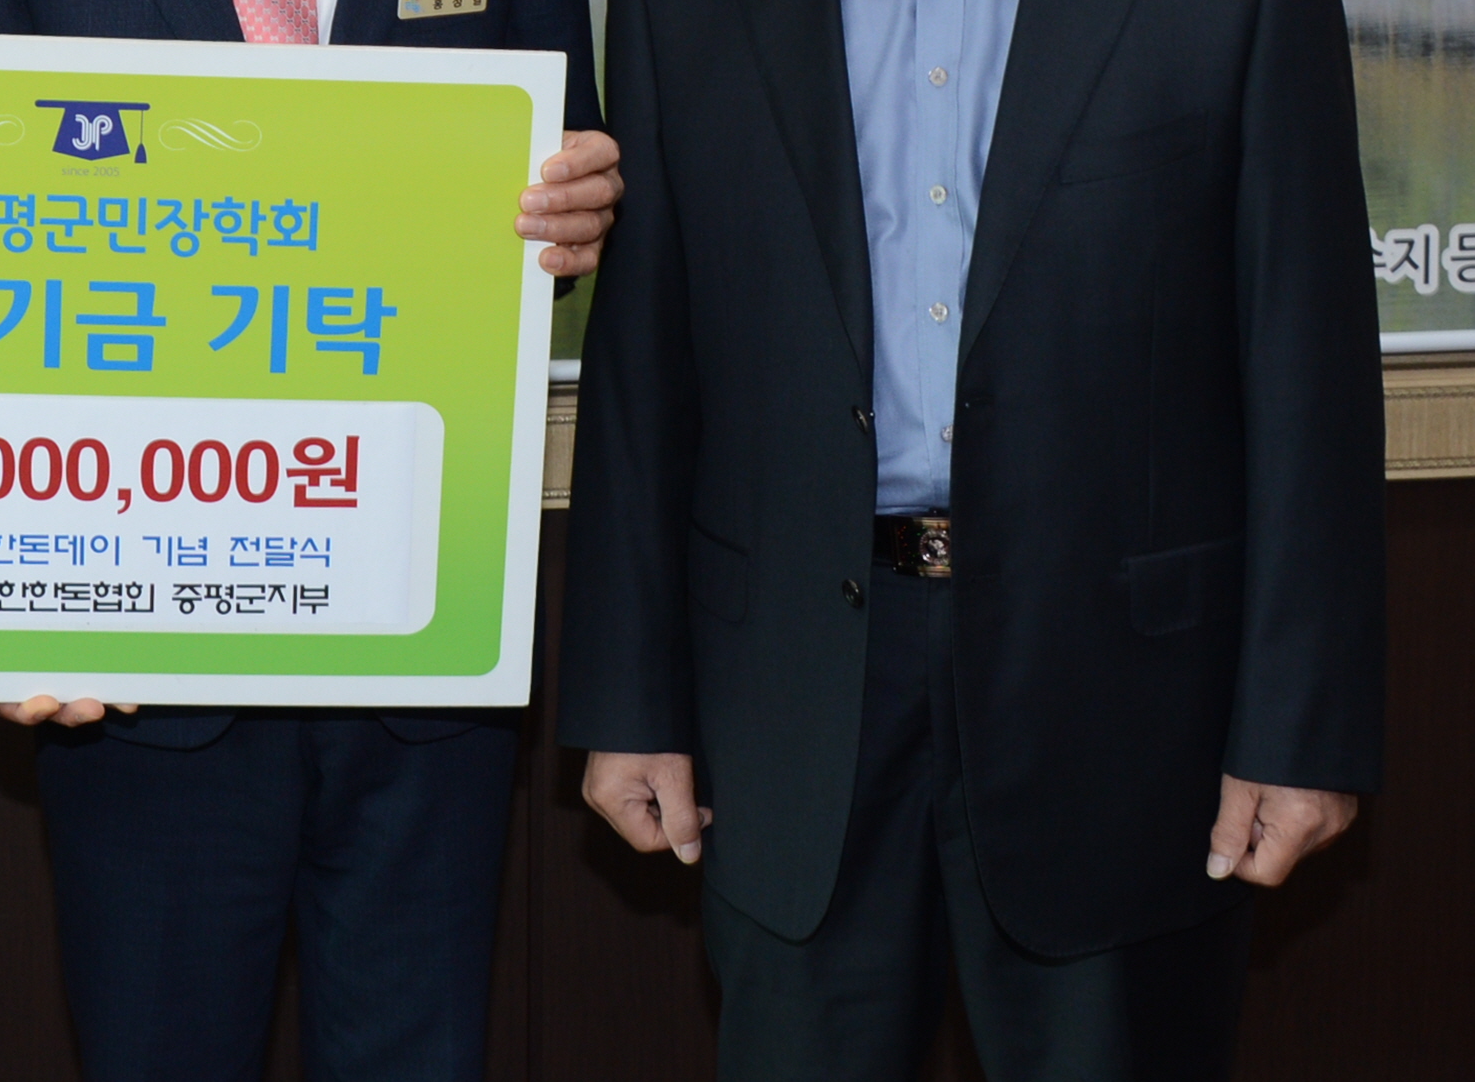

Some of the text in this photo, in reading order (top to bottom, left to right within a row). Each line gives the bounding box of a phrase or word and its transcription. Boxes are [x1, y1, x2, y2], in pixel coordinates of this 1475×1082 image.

[62, 166, 120, 177] since 2005
[208, 284, 398, 376] 기탁
[141, 534, 210, 568] 기념
[228, 535, 333, 569] 전달식
[172, 583, 330, 616] 증평군지부
